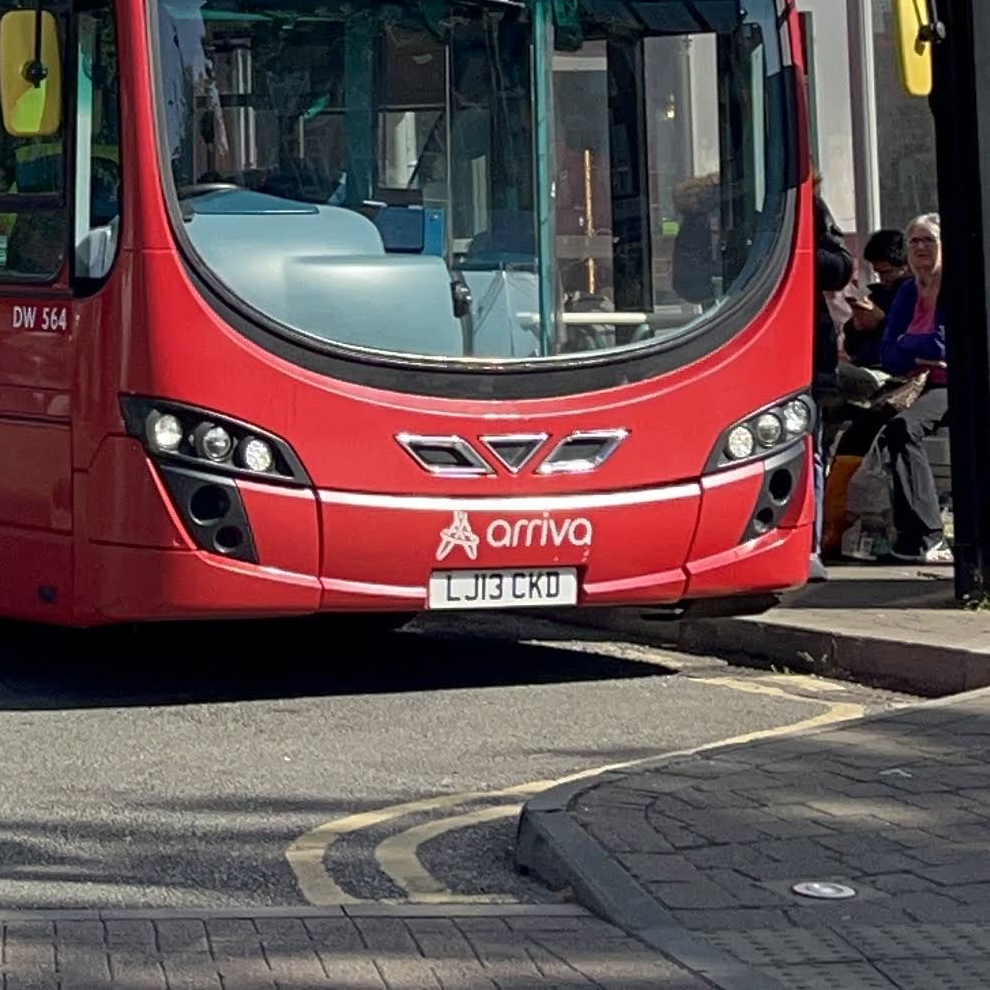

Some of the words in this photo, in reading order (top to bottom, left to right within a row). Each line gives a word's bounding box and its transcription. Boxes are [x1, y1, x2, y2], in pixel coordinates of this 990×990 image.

[12, 305, 37, 328] DW
[41, 307, 67, 330] 564
[486, 511, 593, 547] arriva
[446, 574, 504, 602] LJ13
[512, 571, 560, 599] CKD
